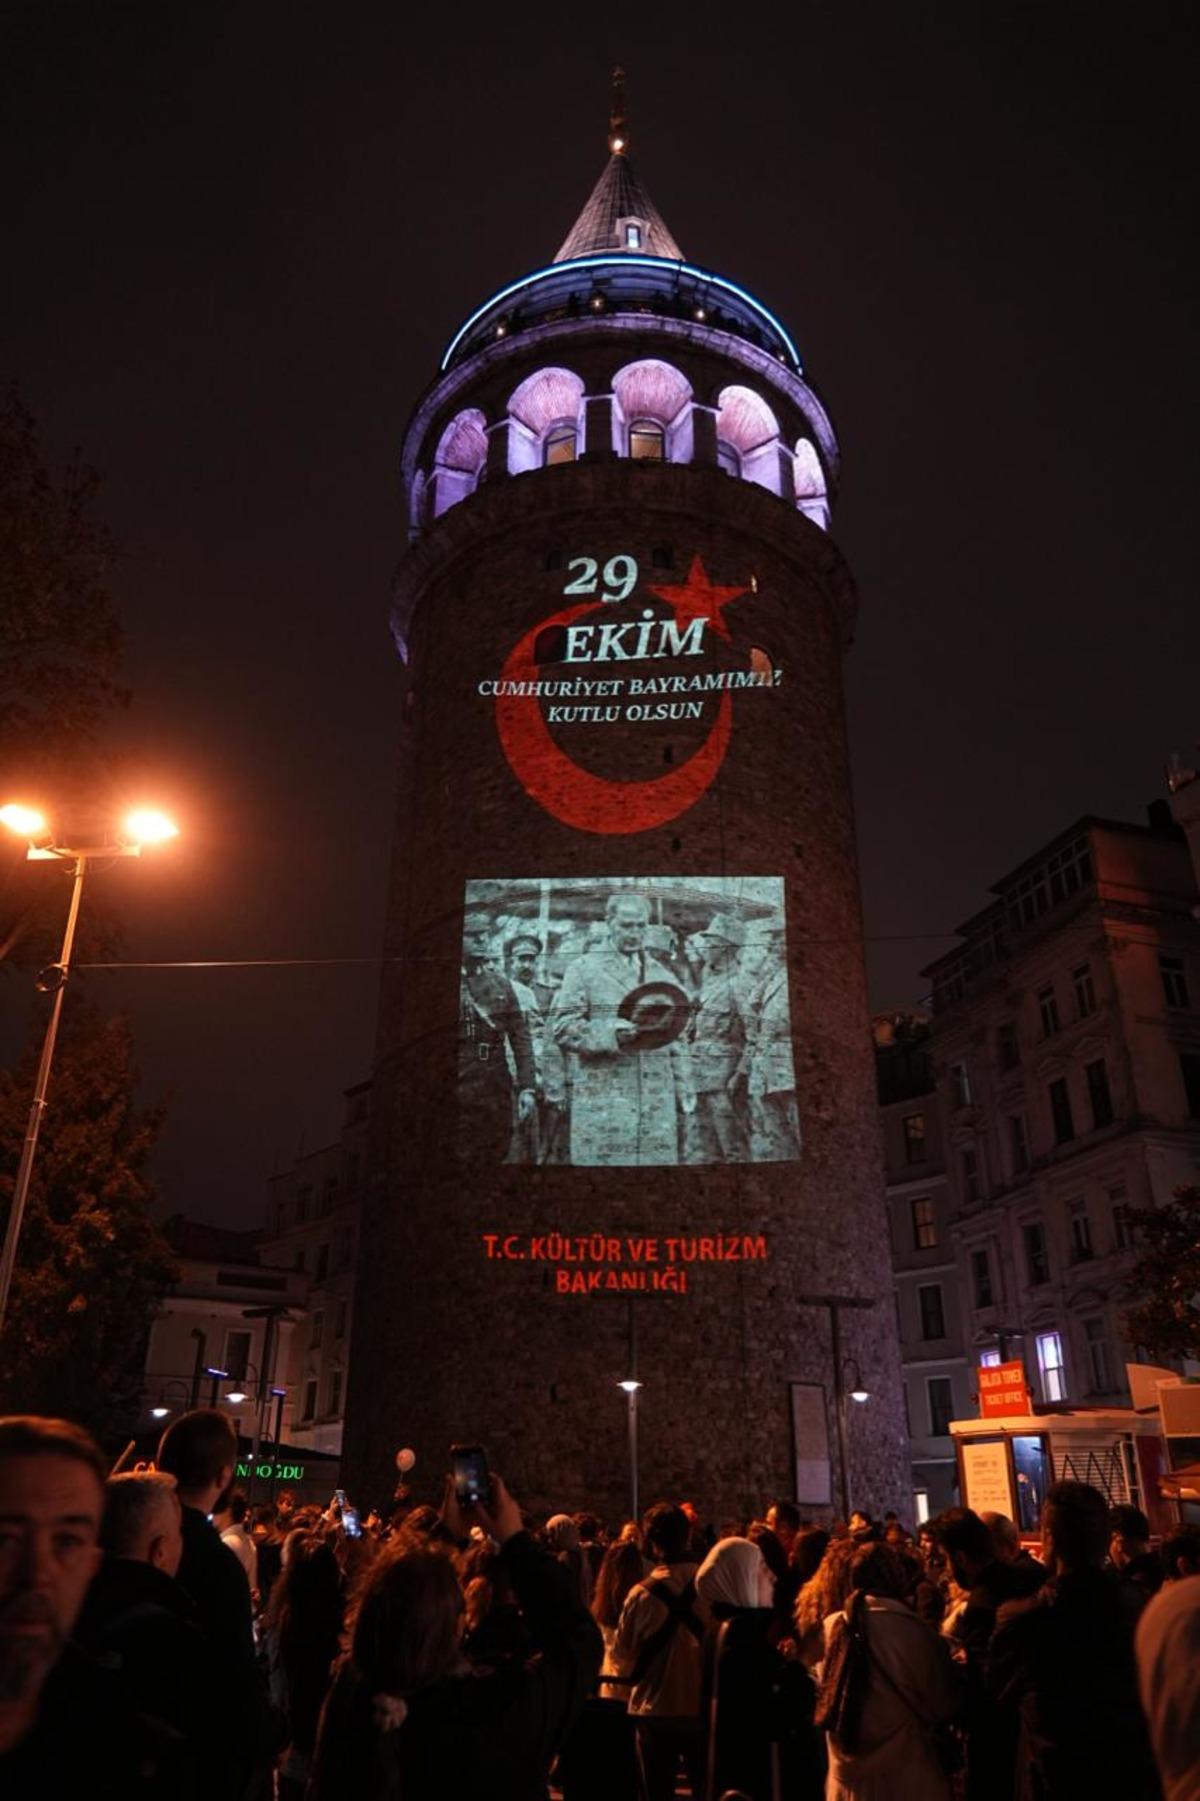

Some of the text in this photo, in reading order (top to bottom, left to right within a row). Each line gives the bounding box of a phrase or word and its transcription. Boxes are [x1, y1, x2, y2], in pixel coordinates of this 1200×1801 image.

[563, 554, 638, 602] 29
[562, 608, 710, 663] EKİM
[478, 675, 623, 697] CUMHURİYET
[547, 701, 704, 722] KUTLU OLSUN
[482, 1232, 767, 1262] T.C. KÜLTÜR VE TURİZM
